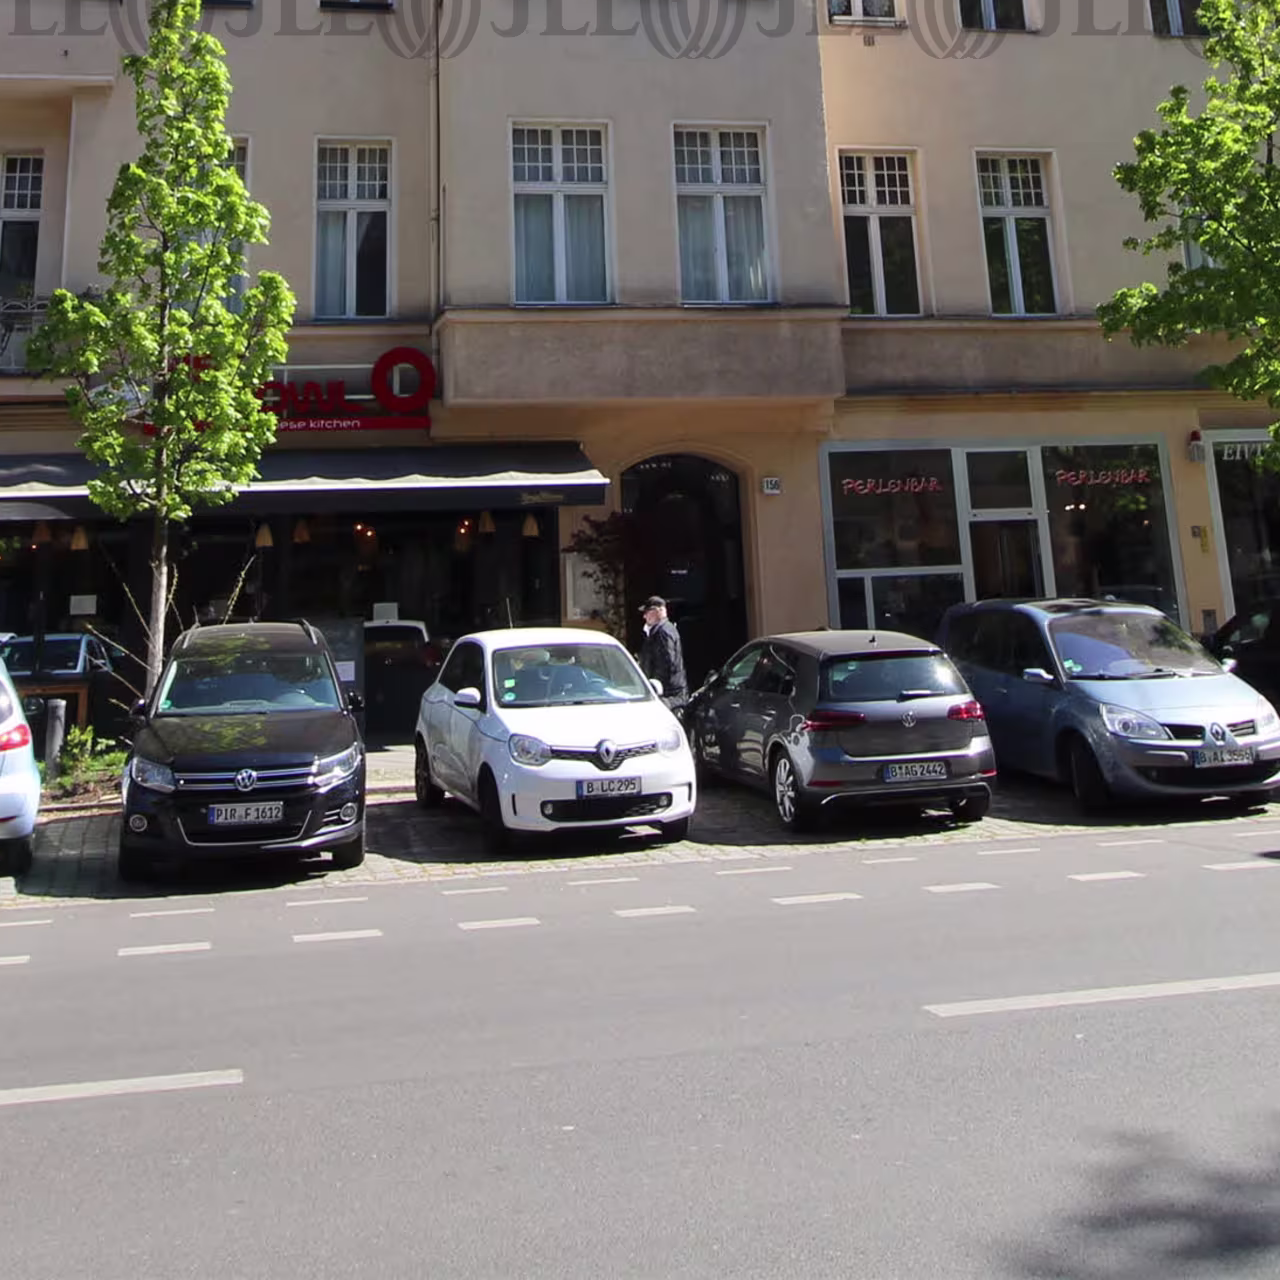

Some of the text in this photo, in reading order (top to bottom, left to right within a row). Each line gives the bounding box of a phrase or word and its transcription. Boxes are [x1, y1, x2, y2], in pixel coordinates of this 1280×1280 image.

[309, 419, 361, 430] kitchen
[841, 477, 945, 495] PERLENBAR
[1055, 469, 1151, 489] PERLENBAR
[920, 763, 945, 776] 2442
[617, 778, 636, 791] 295
[216, 808, 237, 821] PIR
[254, 806, 281, 820] 1612
